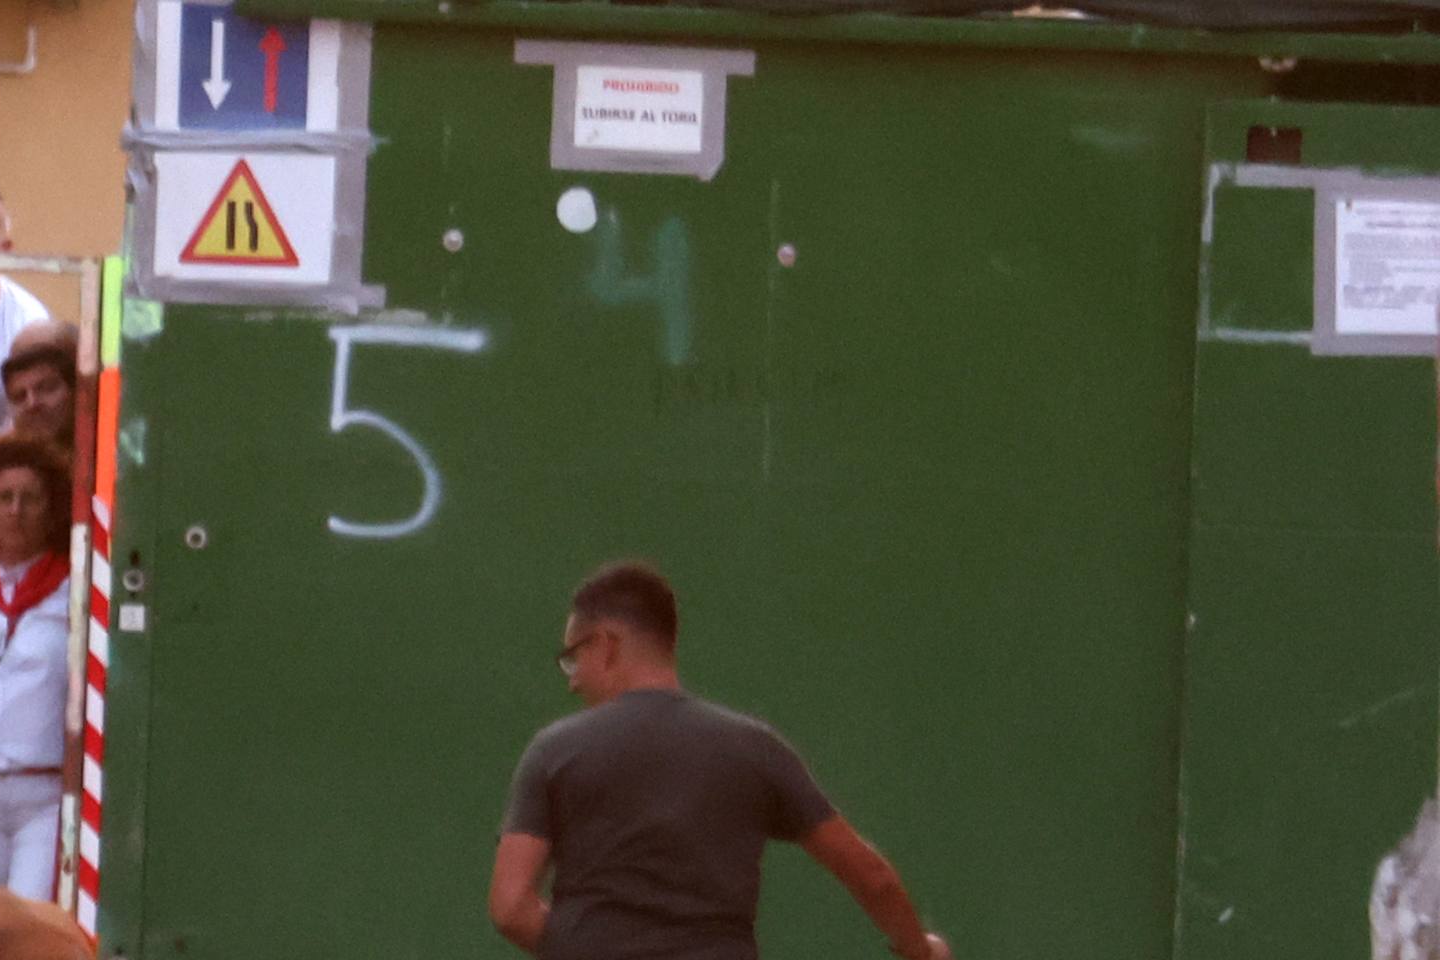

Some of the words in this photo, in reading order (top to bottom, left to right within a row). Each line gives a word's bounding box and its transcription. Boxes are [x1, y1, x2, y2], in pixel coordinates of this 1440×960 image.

[602, 79, 680, 94] PROHIBIDO
[582, 107, 636, 121] SUBIRSE
[640, 109, 656, 122] AL
[328, 324, 489, 539] 5
